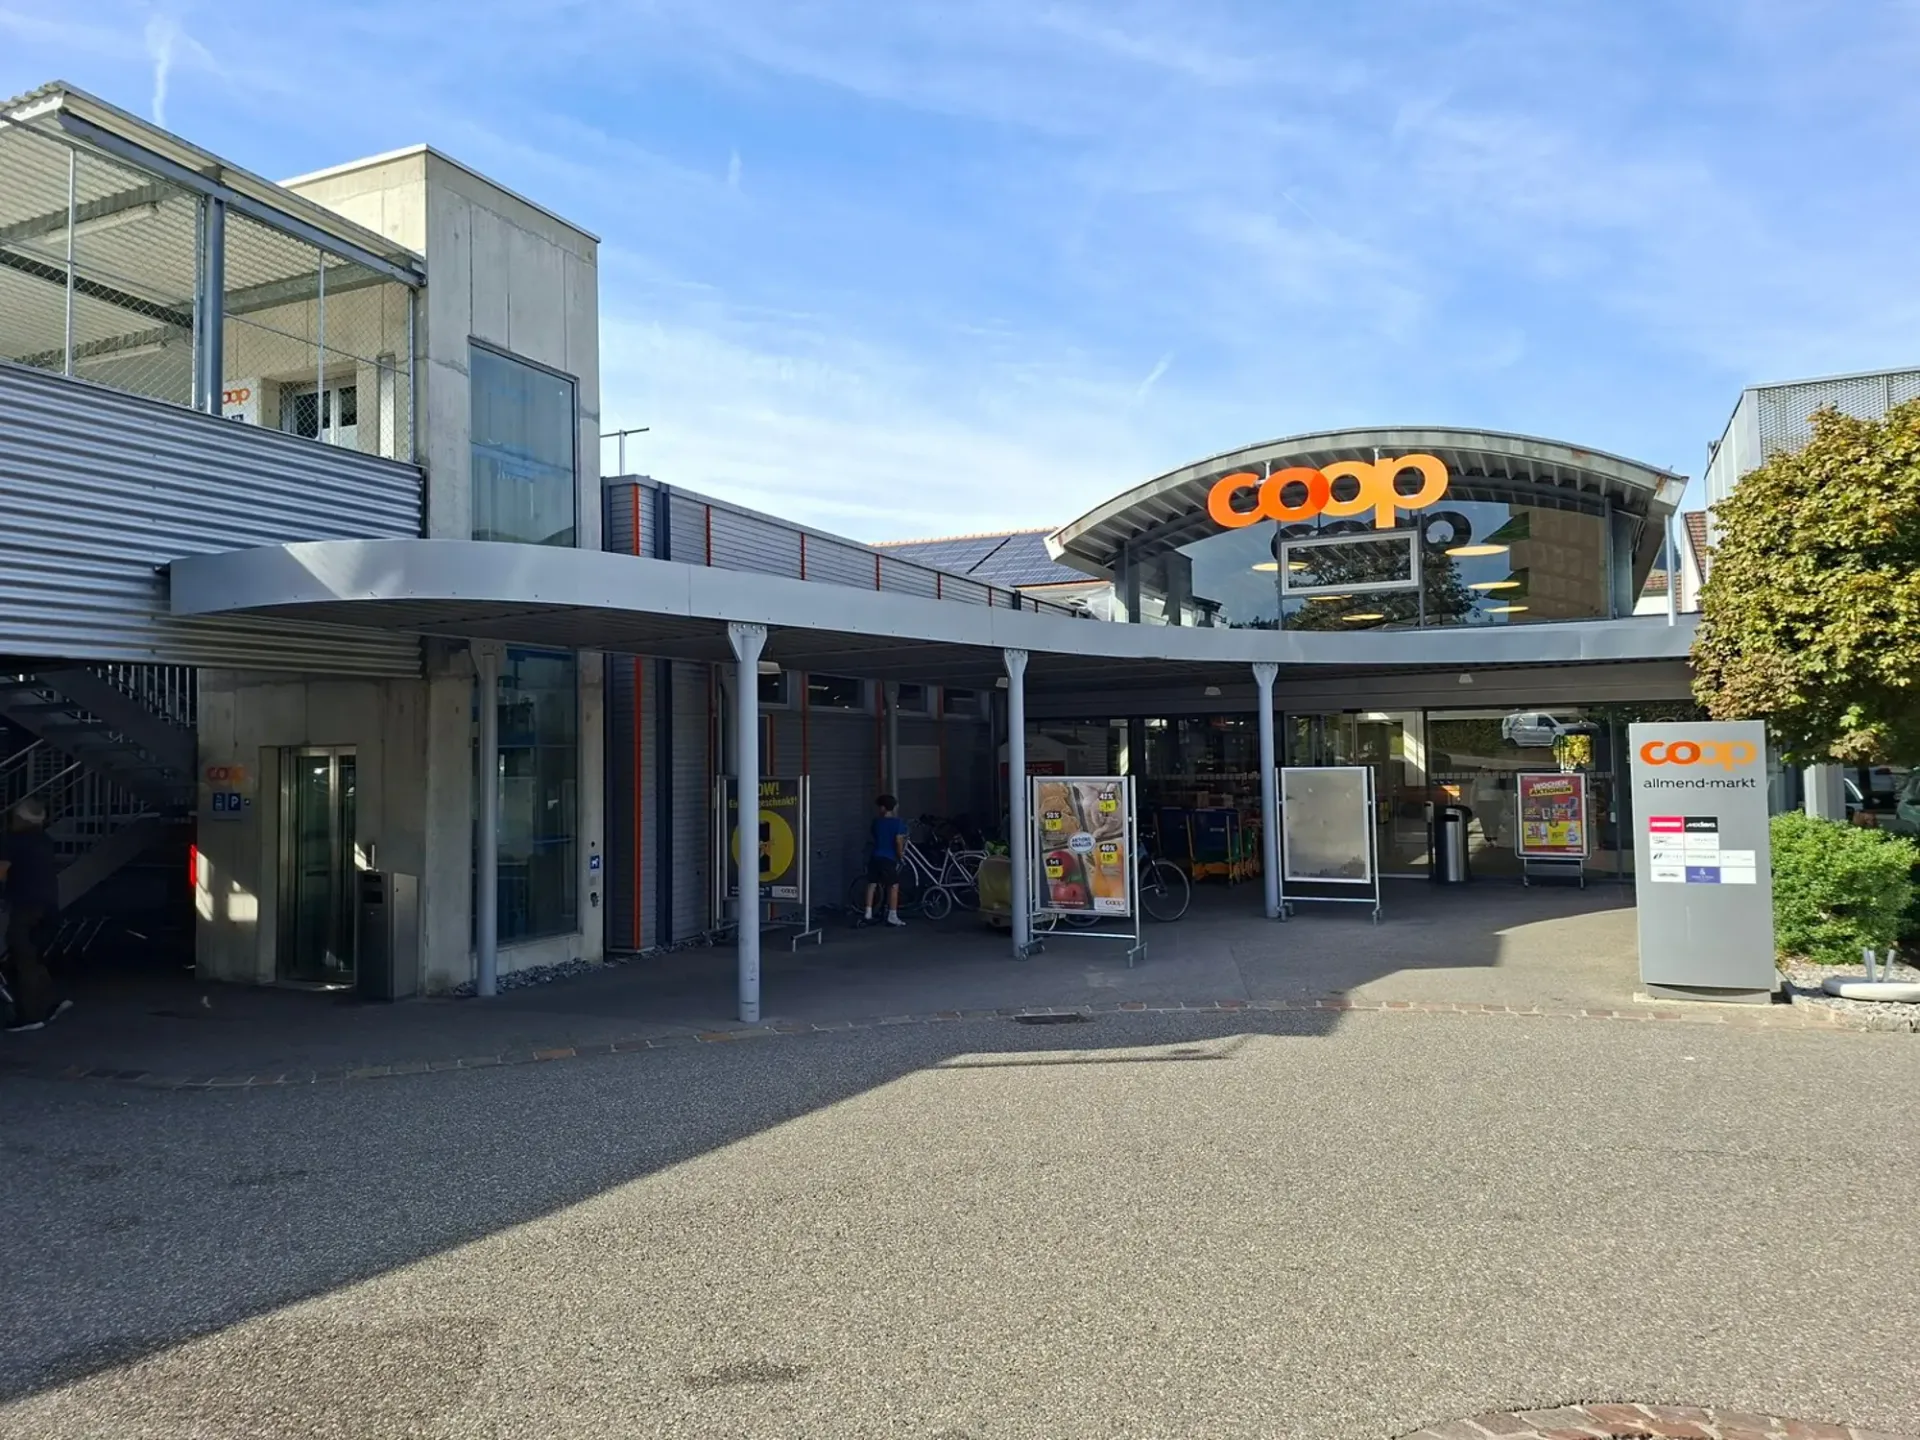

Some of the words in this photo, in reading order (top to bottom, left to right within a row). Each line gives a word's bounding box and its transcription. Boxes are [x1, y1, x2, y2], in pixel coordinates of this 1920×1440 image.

[1207, 454, 1449, 529] coop
[1640, 740, 1758, 771] coop
[1533, 780, 1569, 789] WOCHEN
[1643, 777, 1756, 789] allmend-markt
[1531, 786, 1571, 795] AKTIONEN
